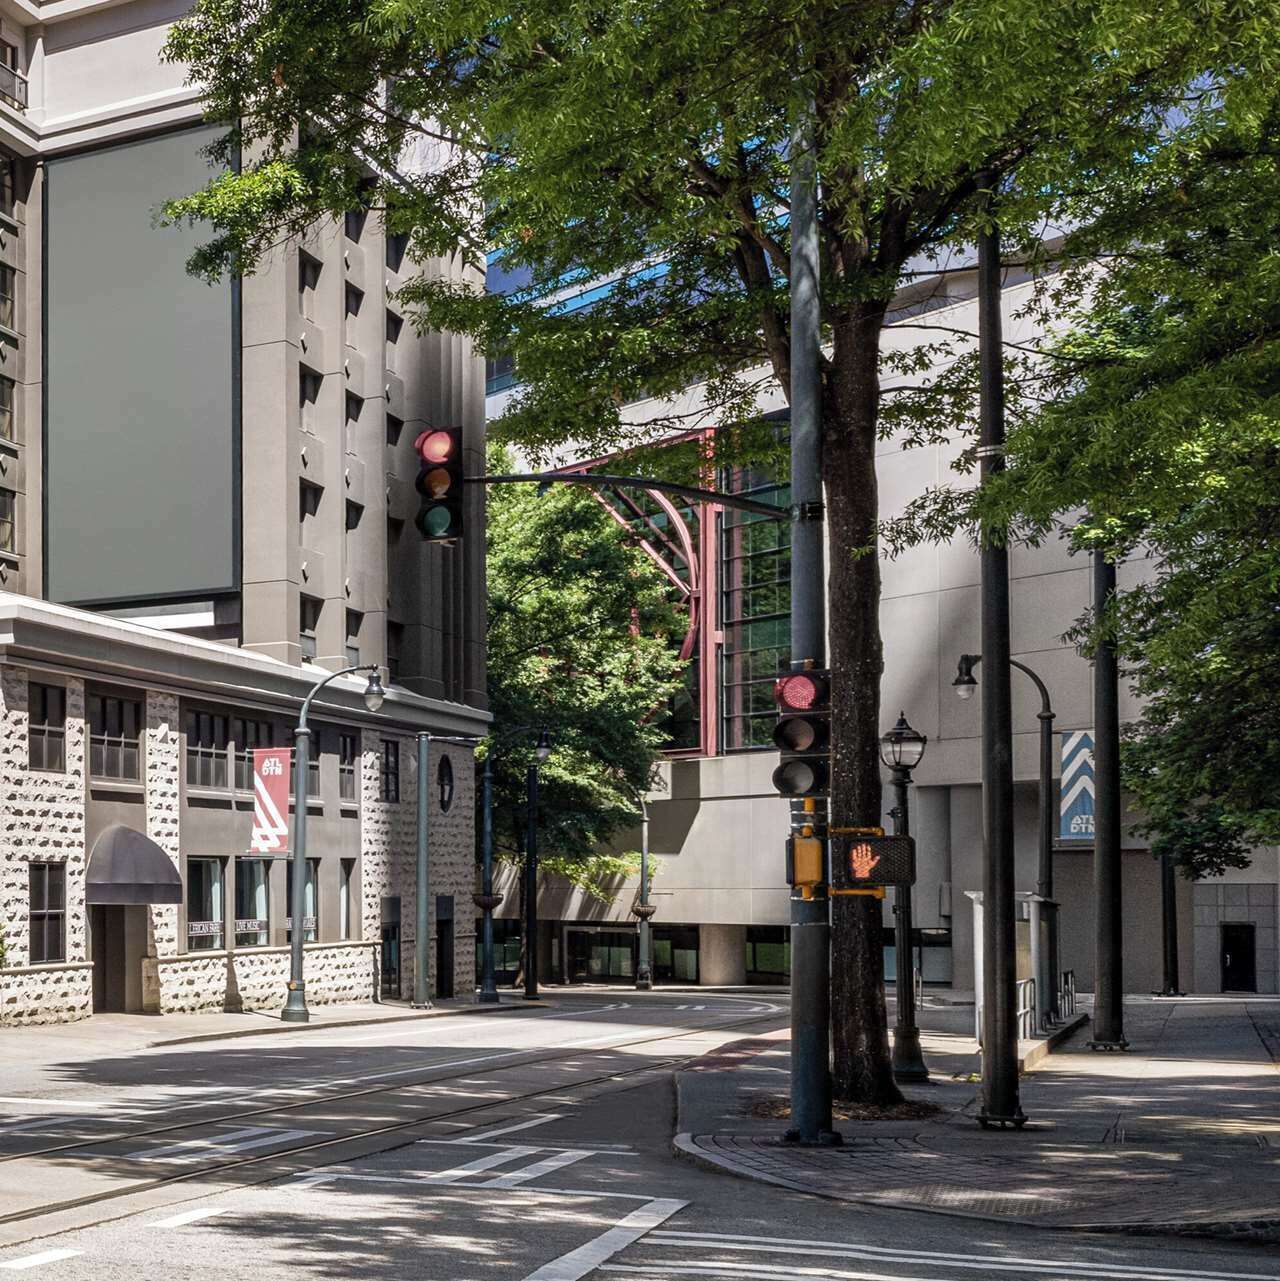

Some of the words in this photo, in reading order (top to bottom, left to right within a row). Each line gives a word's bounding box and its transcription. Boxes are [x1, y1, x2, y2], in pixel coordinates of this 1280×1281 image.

[263, 757, 282, 767] ATL
[262, 766, 282, 776] DTN
[1071, 823, 1095, 833] DTN
